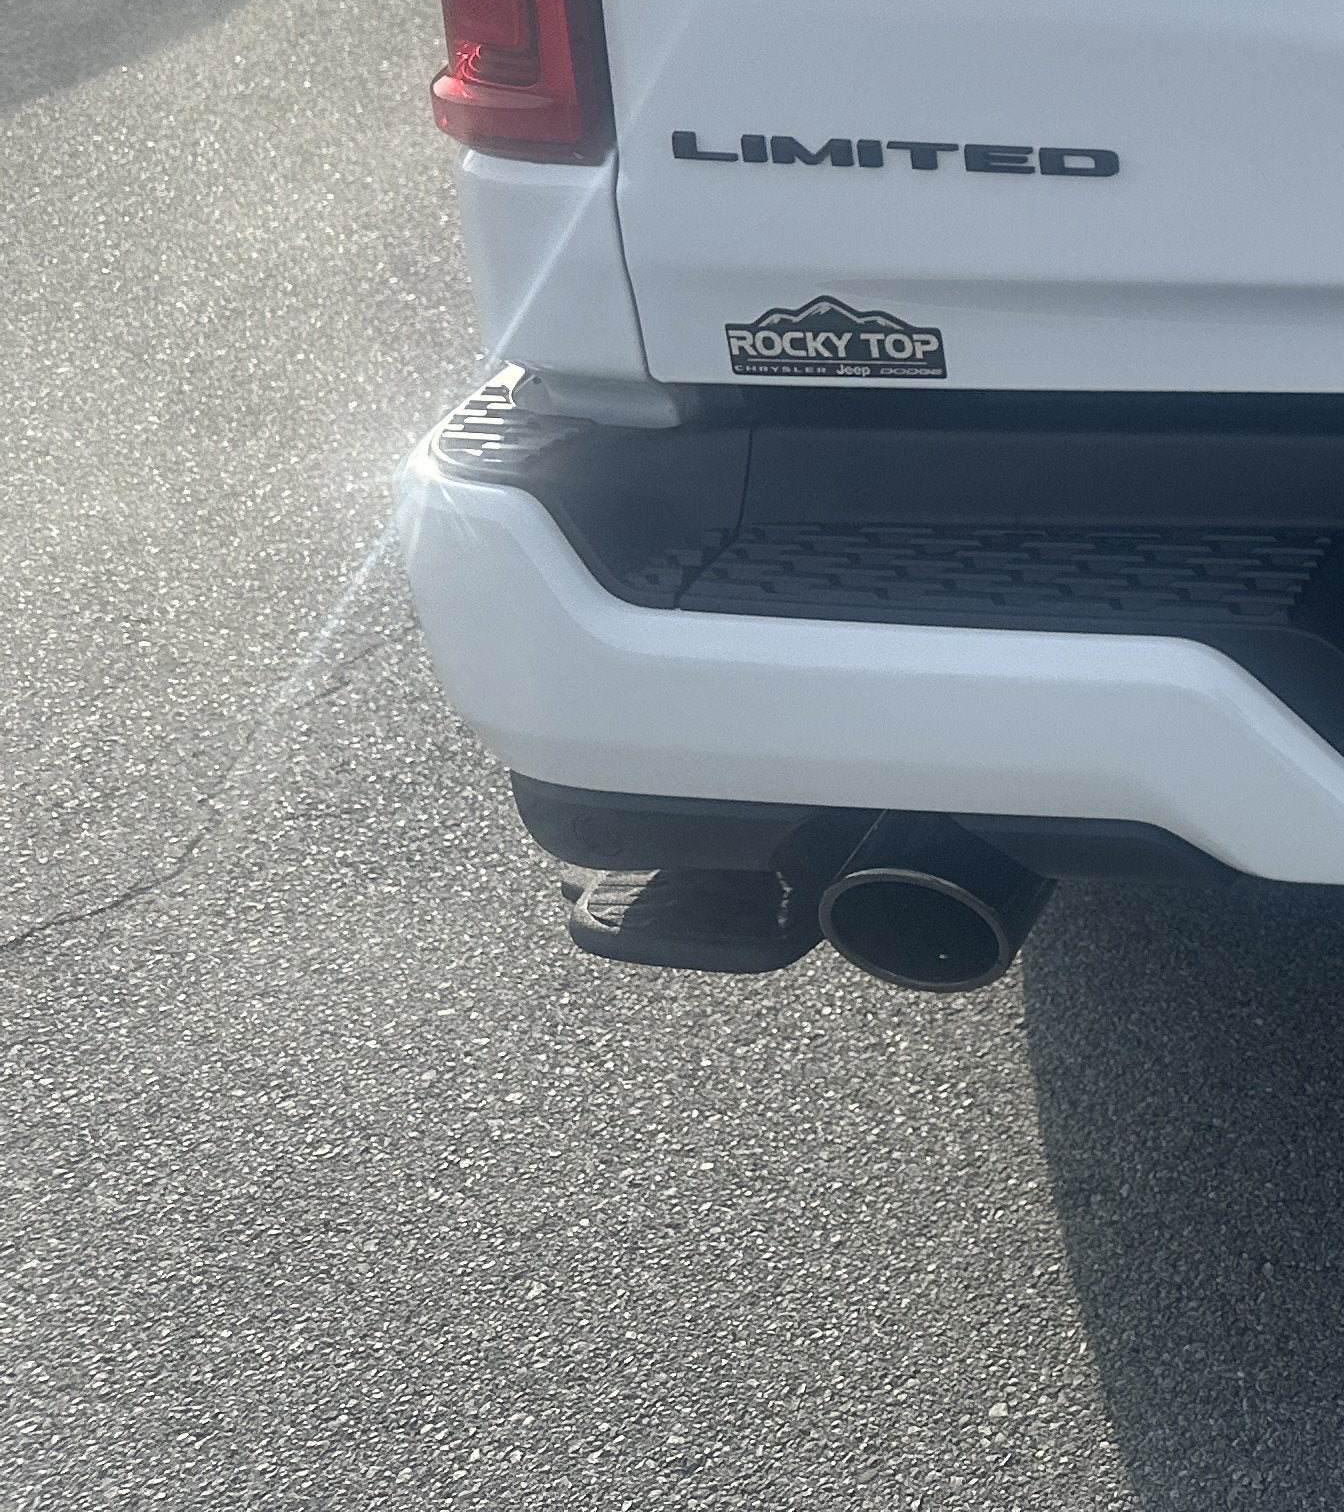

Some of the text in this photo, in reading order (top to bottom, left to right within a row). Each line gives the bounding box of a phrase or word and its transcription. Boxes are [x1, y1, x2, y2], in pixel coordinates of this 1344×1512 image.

[671, 130, 1120, 177] LIMITED
[727, 329, 940, 359] ROCKY TOP
[734, 364, 944, 377] CHRYSLER Jeep DODGE
